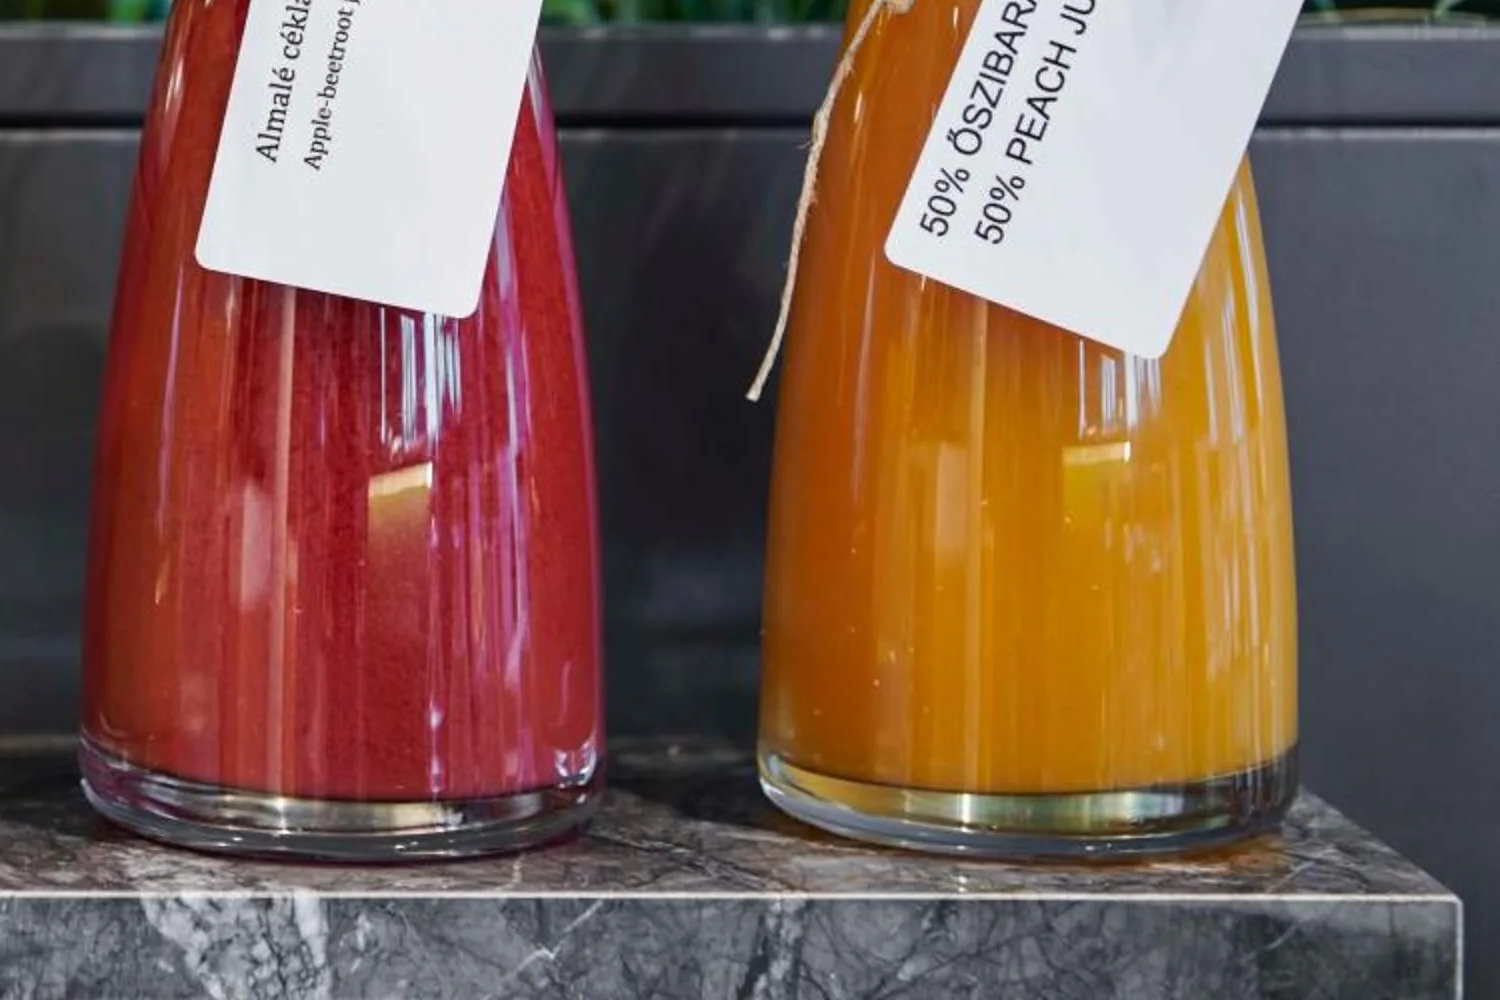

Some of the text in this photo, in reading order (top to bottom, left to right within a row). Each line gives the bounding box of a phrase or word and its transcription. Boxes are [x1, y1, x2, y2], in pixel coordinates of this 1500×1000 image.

[256, 67, 295, 163] Almalé
[304, 6, 354, 170] Apple-beetroot
[975, 176, 1025, 244] 50%
[1005, 40, 1077, 165] PEACH
[920, 168, 969, 237] 50%
